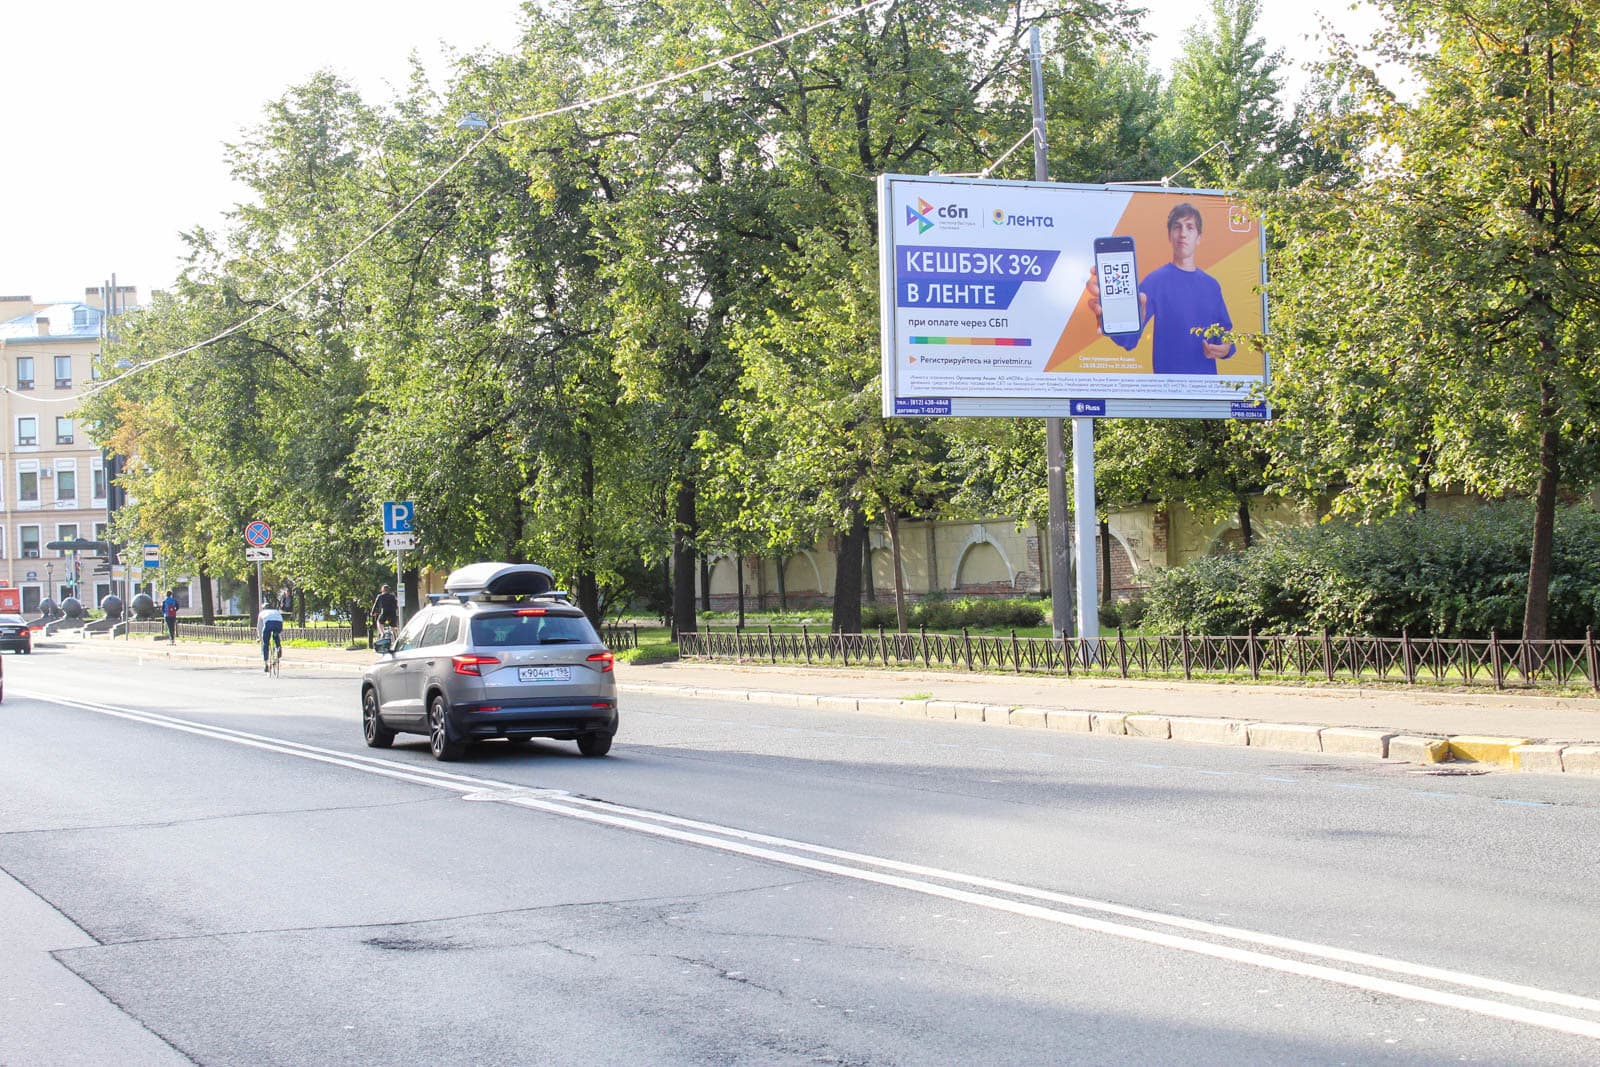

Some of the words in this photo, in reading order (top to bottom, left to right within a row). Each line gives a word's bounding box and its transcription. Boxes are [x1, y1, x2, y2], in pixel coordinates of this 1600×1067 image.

[938, 204, 968, 219] сбп
[1006, 214, 1054, 229] лента
[906, 251, 1004, 275] КЕШБЭК
[1008, 254, 1042, 277] 3%
[907, 283, 920, 303] В
[926, 284, 996, 305] ЛЕНТЕ
[908, 319, 926, 328] при
[927, 319, 959, 328] оплате
[961, 319, 987, 329] через
[988, 318, 1009, 328] СБП
[920, 355, 982, 366] Регистрируйтесь
[992, 357, 1032, 368] privetmir.ru
[391, 504, 409, 529] P
